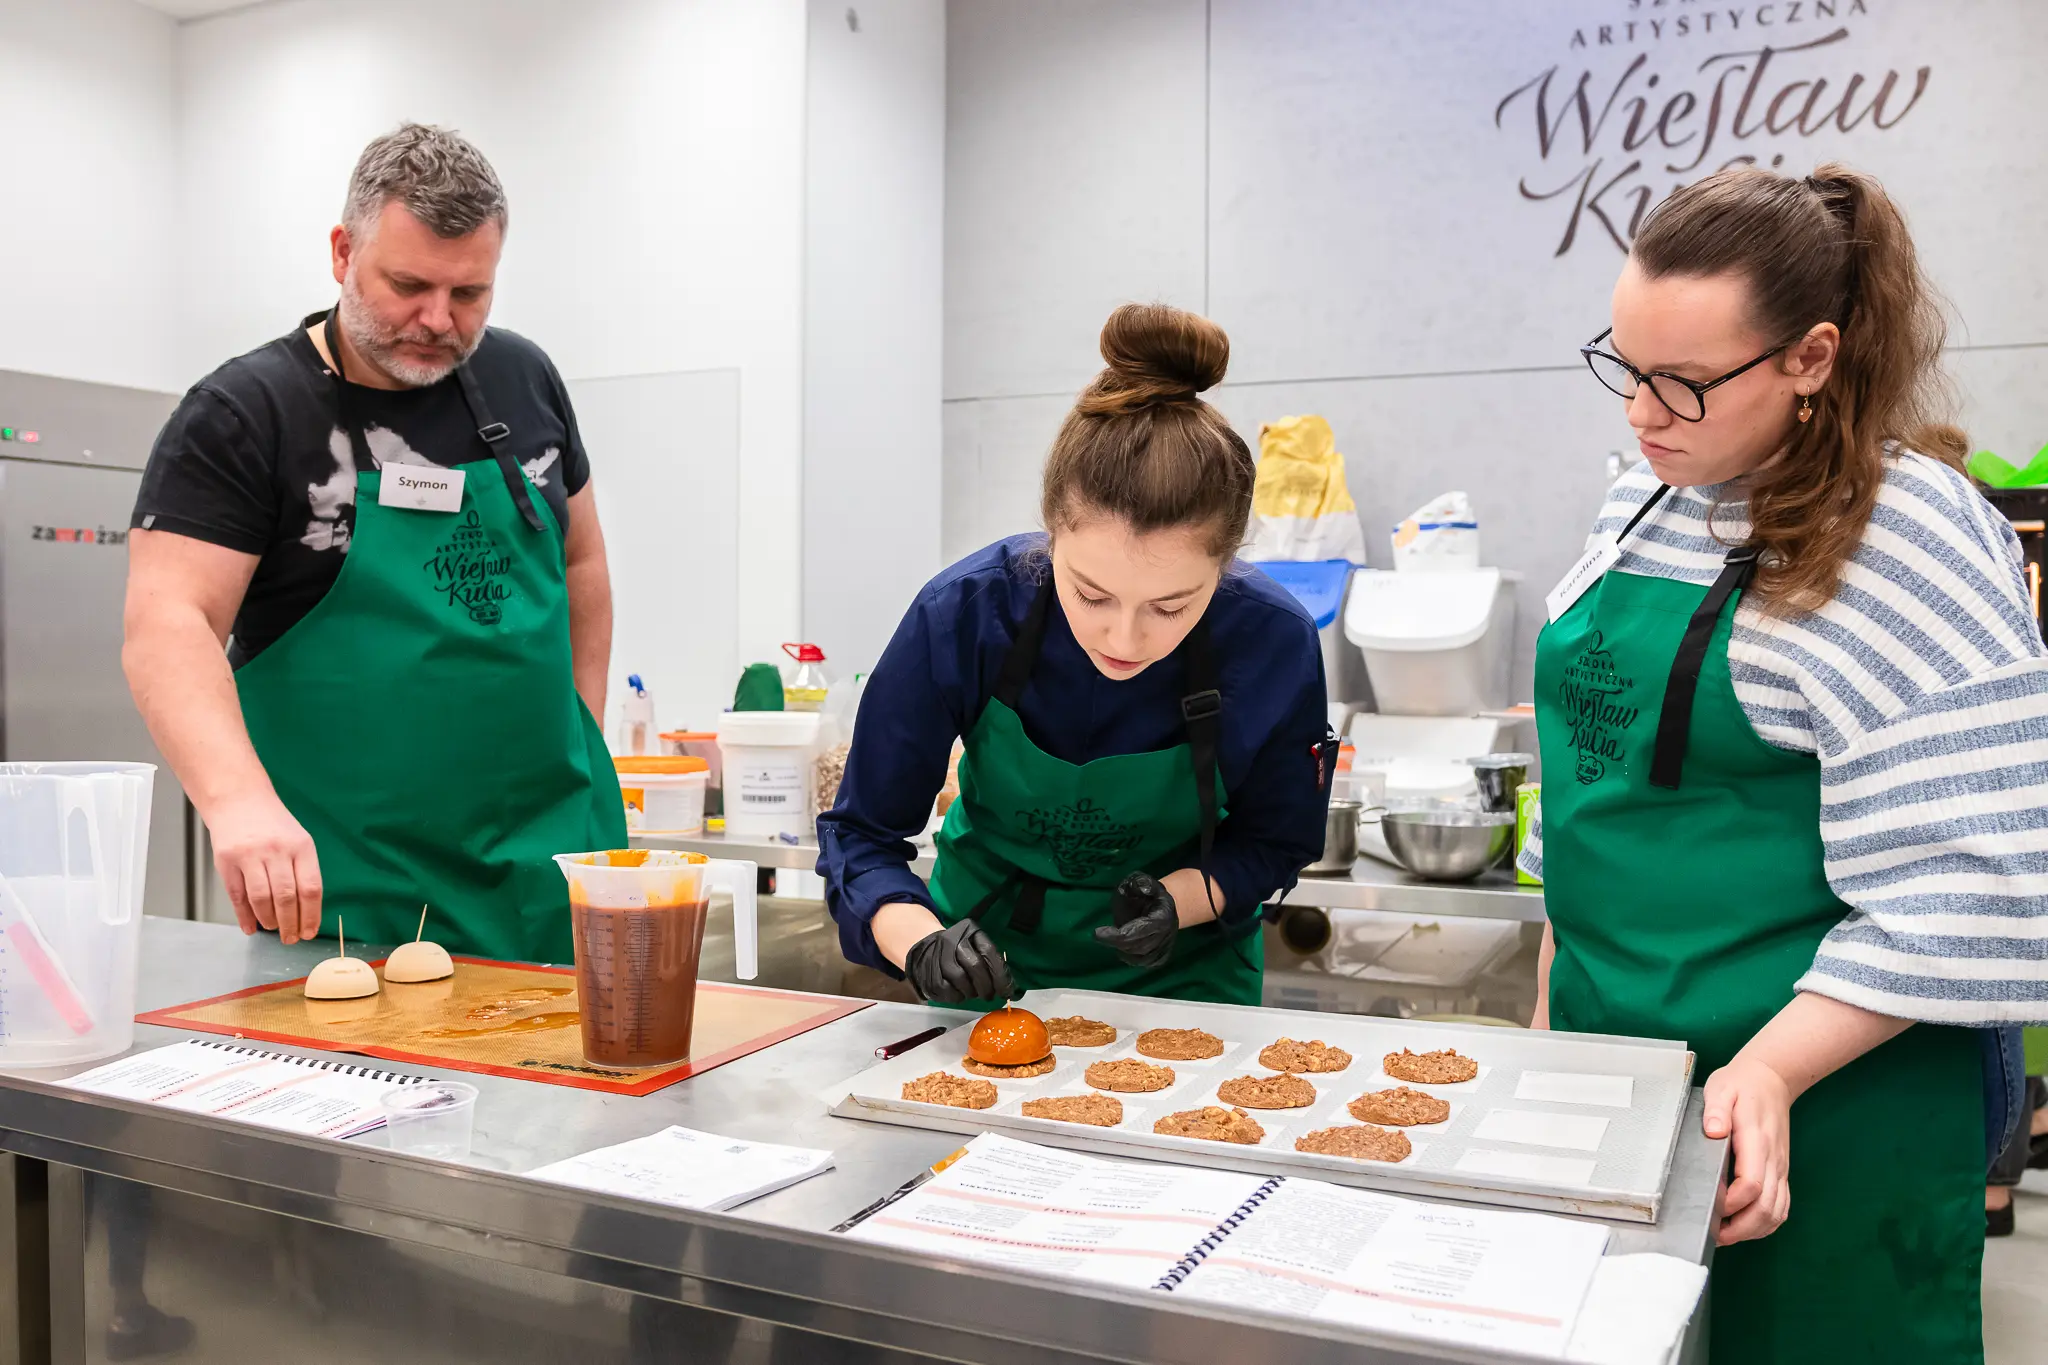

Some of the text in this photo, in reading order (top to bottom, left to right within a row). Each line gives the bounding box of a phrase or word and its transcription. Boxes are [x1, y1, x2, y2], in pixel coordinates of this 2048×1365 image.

[1569, 0, 1868, 49] ARTYSTYCZNA
[398, 476, 448, 490] Szymon
[1560, 550, 1603, 597] Karolina
